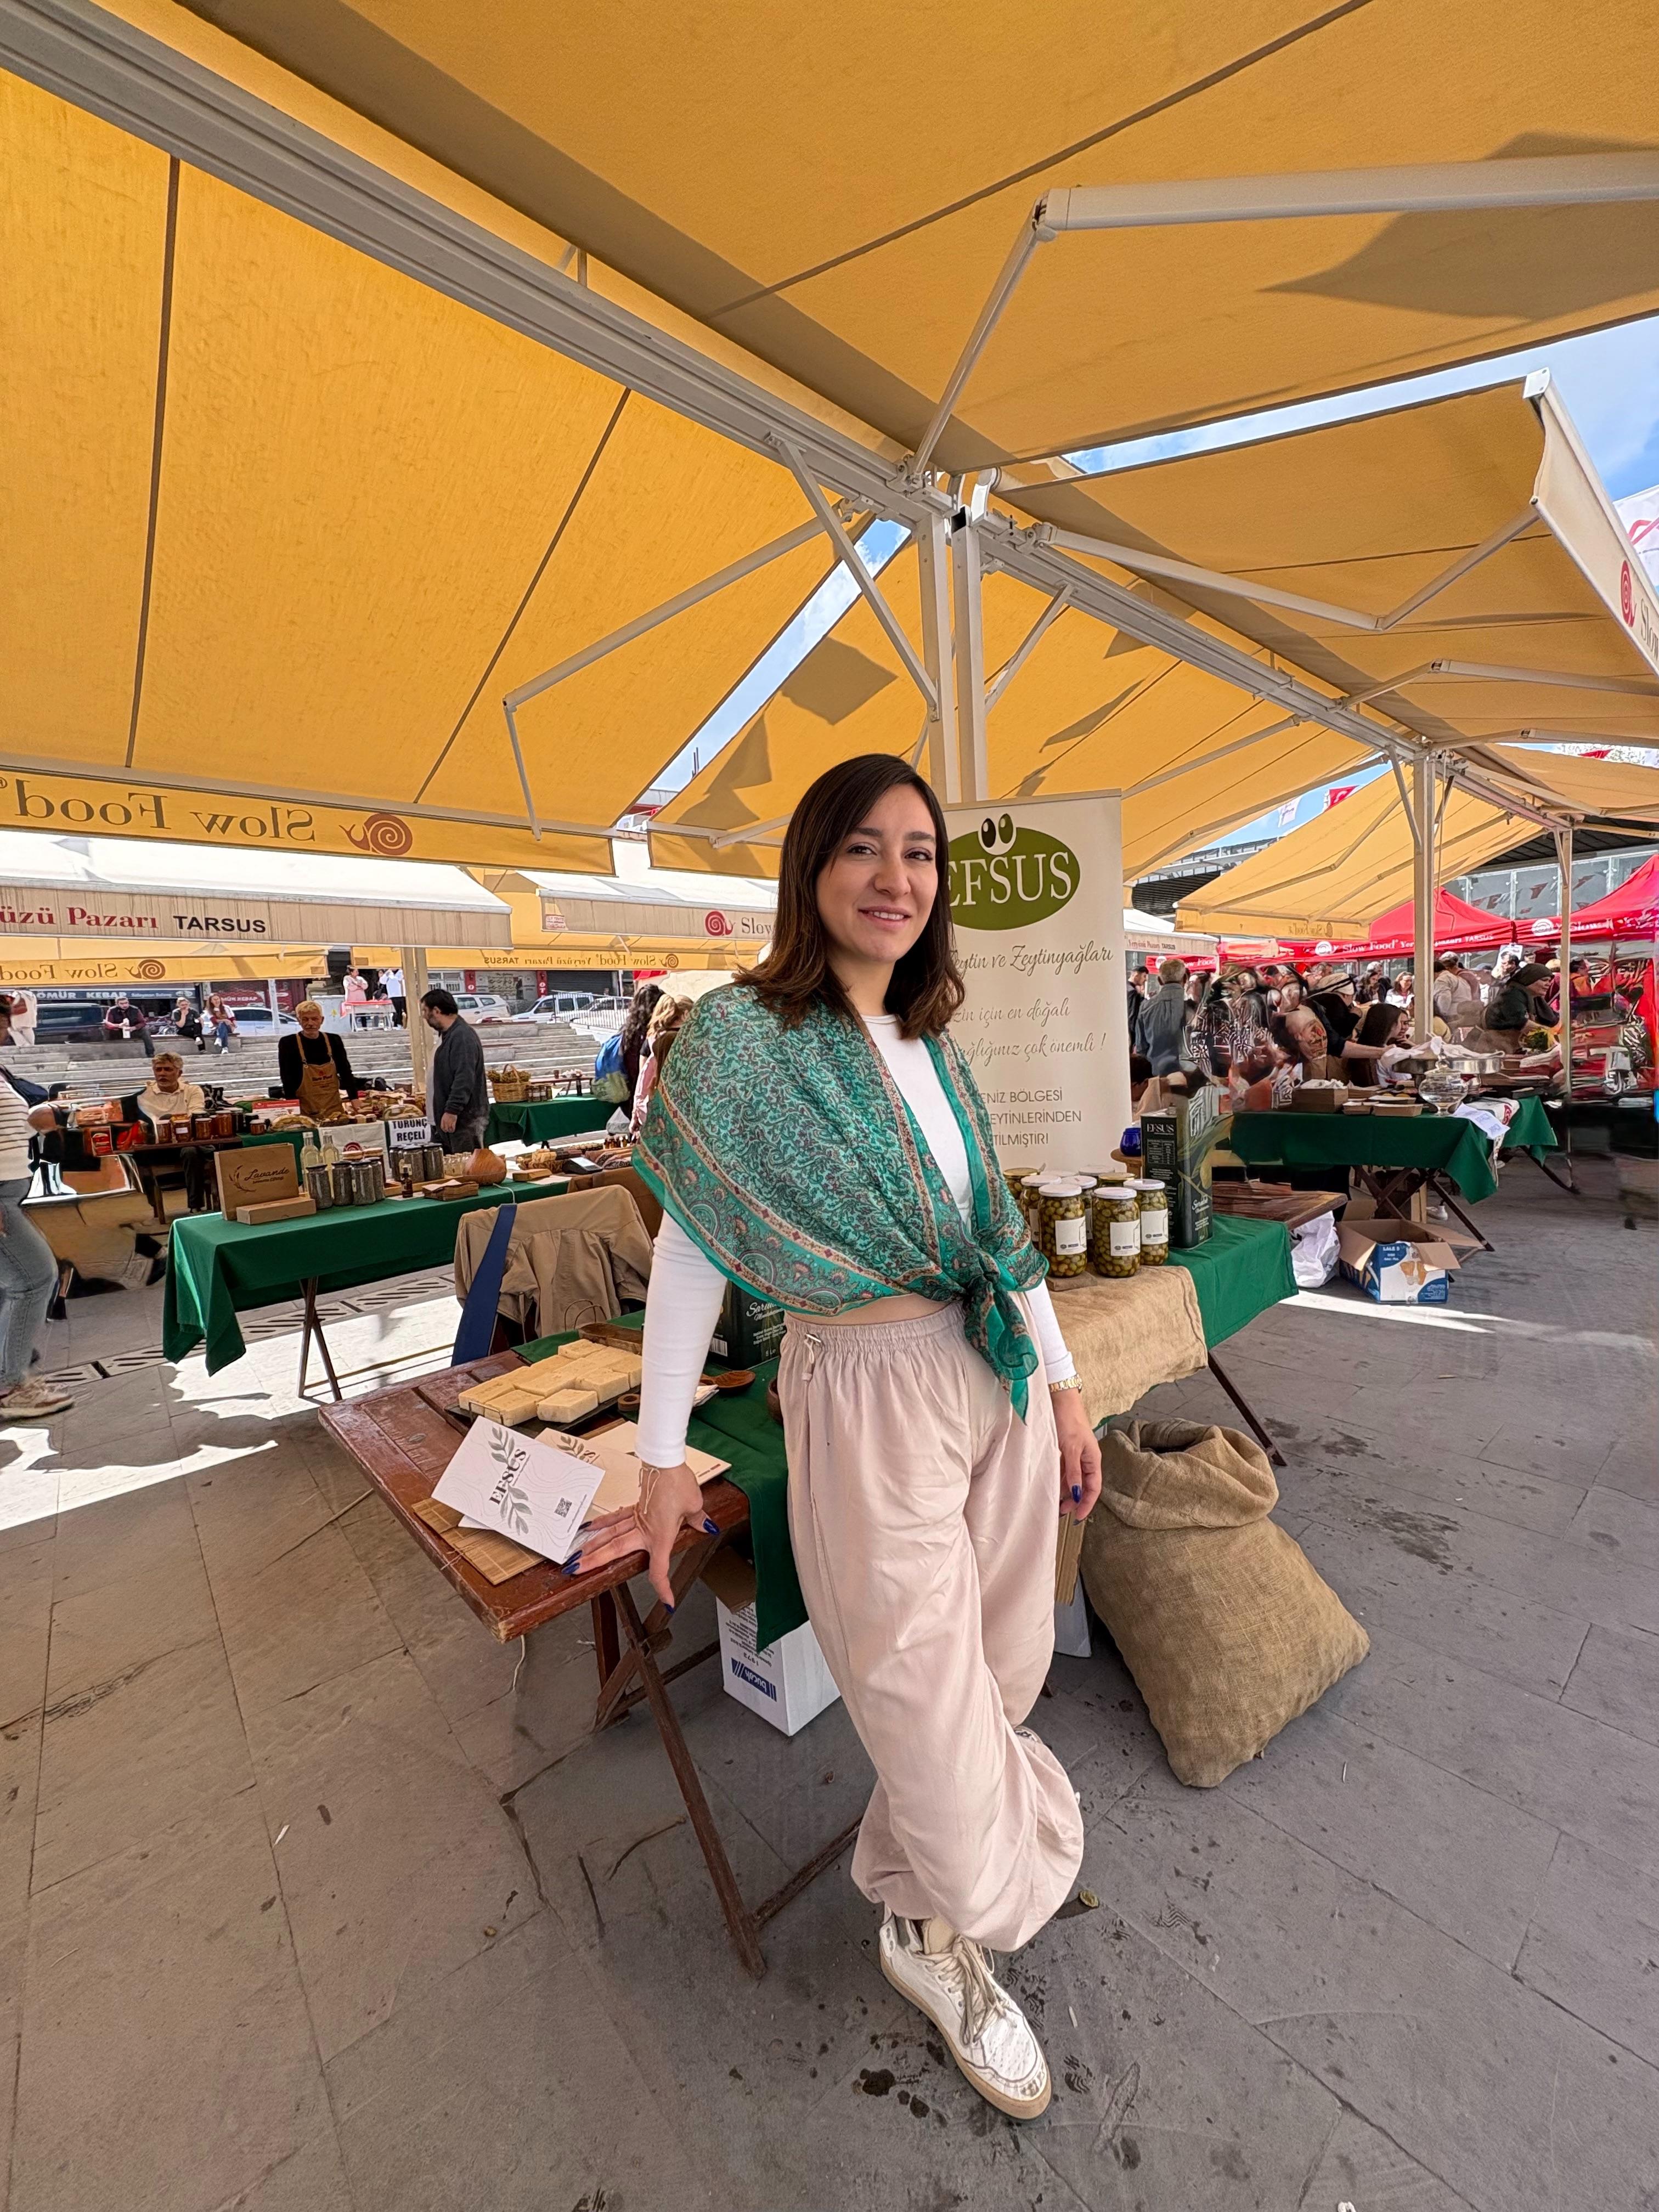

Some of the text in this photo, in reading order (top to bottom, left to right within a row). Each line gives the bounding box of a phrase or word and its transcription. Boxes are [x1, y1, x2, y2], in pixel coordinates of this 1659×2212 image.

[67, 906, 159, 929] Pazarı
[173, 915, 266, 933] TARSUS
[992, 954, 1007, 969] ve
[1010, 940, 1114, 977] Zeytinyağları
[1344, 941, 1367, 953] Slow
[979, 1007, 1003, 1028] için
[1008, 1008, 1024, 1019] en
[1027, 997, 1070, 1028] doğalı
[1024, 1034, 1049, 1062] çok
[1050, 1032, 1096, 1053] önemli
[1010, 1087, 1063, 1102] BÖLGESİ
[392, 1118, 427, 1129] TURUNÇ
[397, 1129, 425, 1142] REÇELİ
[489, 1448, 527, 1505] EFSUS
[744, 1669, 768, 1694] bucak
